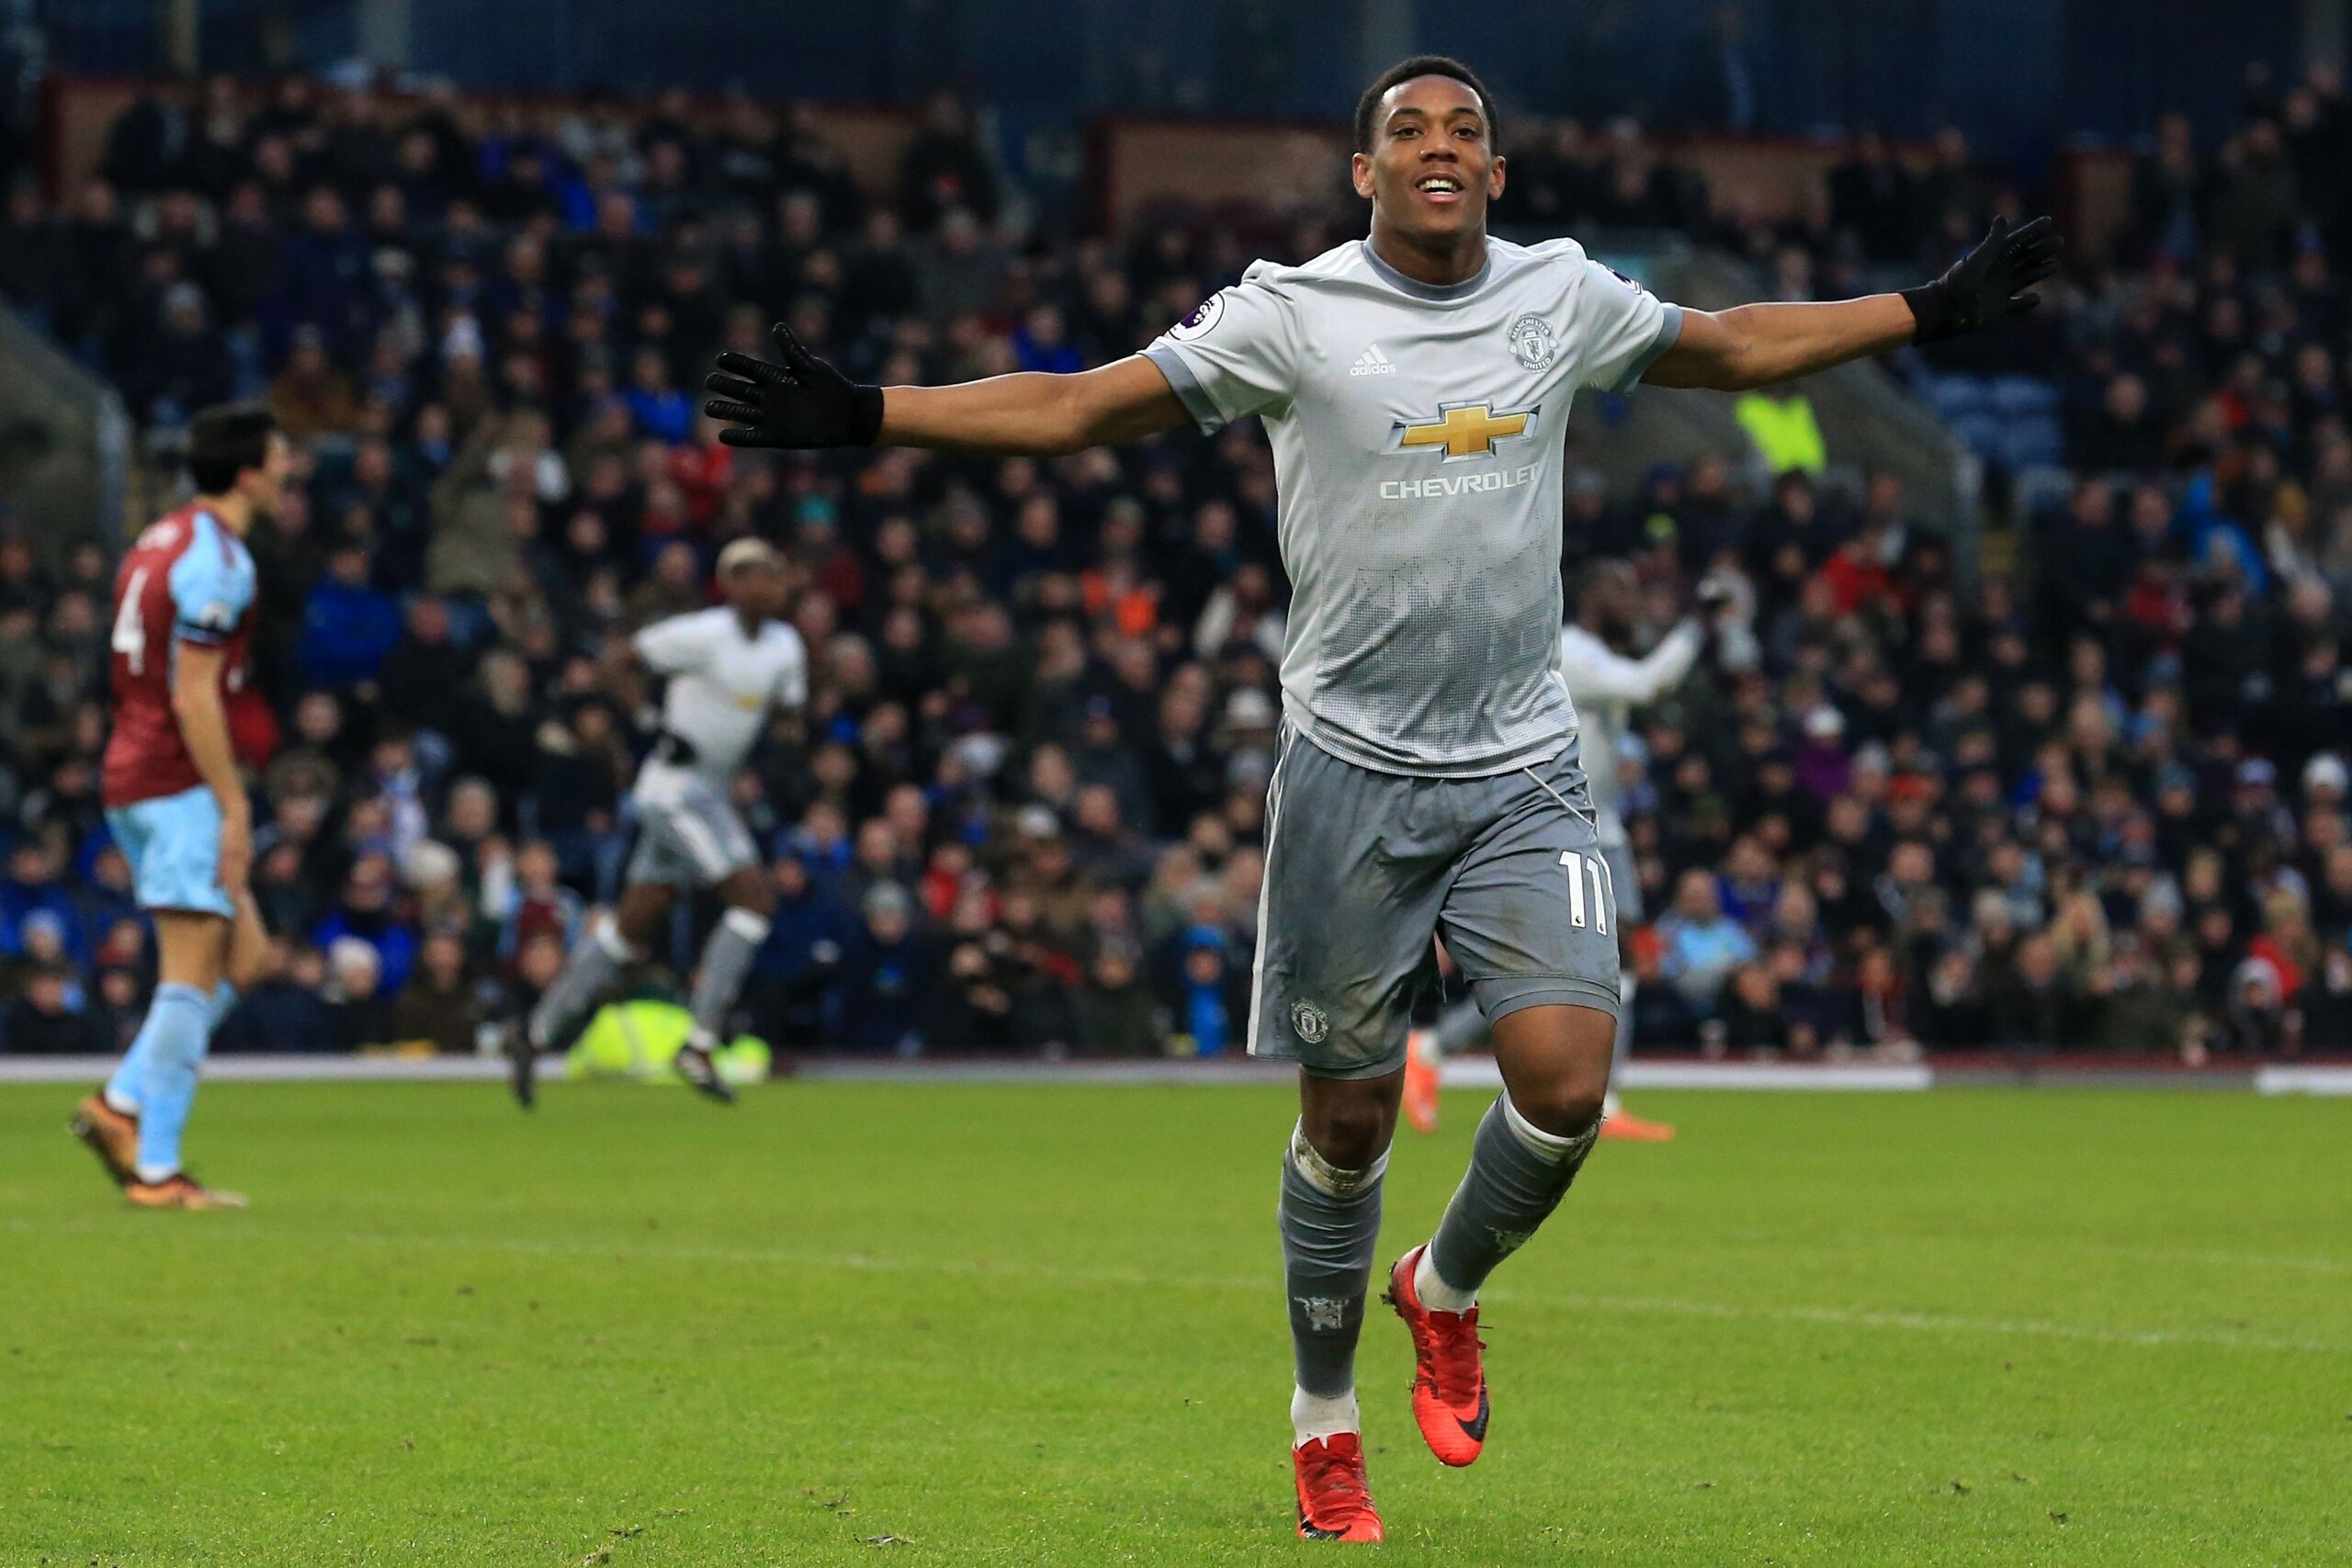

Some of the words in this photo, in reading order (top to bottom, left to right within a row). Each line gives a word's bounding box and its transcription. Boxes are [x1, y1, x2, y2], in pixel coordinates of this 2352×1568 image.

[1510, 318, 1550, 339] MANCHESTER
[1350, 363, 1396, 377] adidas
[1523, 357, 1551, 369] UNITED
[1380, 462, 1539, 500] CHEVROLET
[111, 566, 147, 676] 4
[1558, 850, 1608, 937] 11
